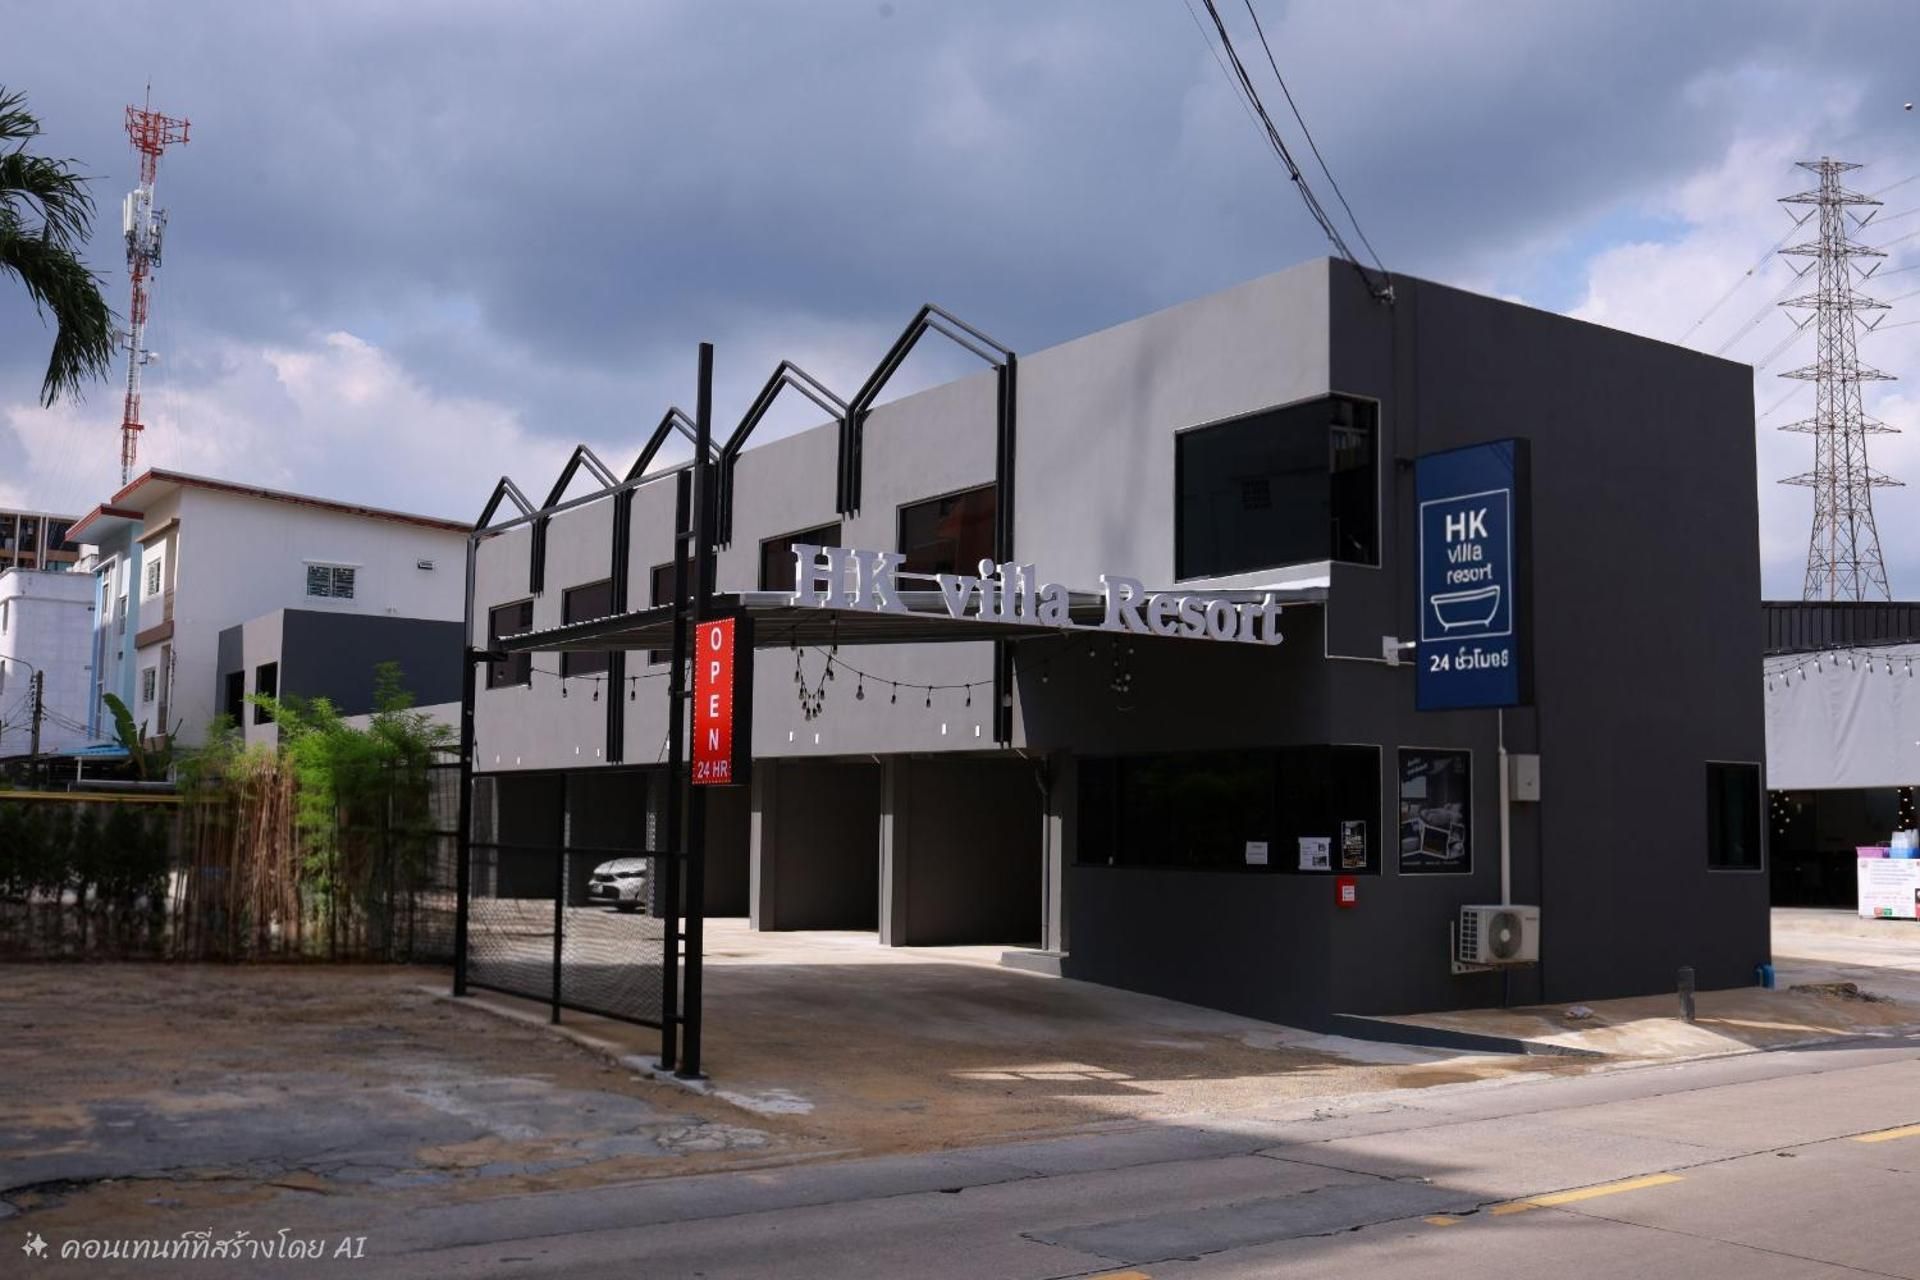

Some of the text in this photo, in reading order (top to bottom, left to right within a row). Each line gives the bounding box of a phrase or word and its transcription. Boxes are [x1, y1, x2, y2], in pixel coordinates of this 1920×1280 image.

[1446, 508, 1488, 542] HK
[1447, 543, 1482, 563] villa
[1447, 563, 1493, 585] resort
[791, 543, 1284, 646] HK villa Resort
[1430, 654, 1449, 672] 24
[708, 627, 722, 751] OPEN
[697, 760, 728, 778] 24 HR
